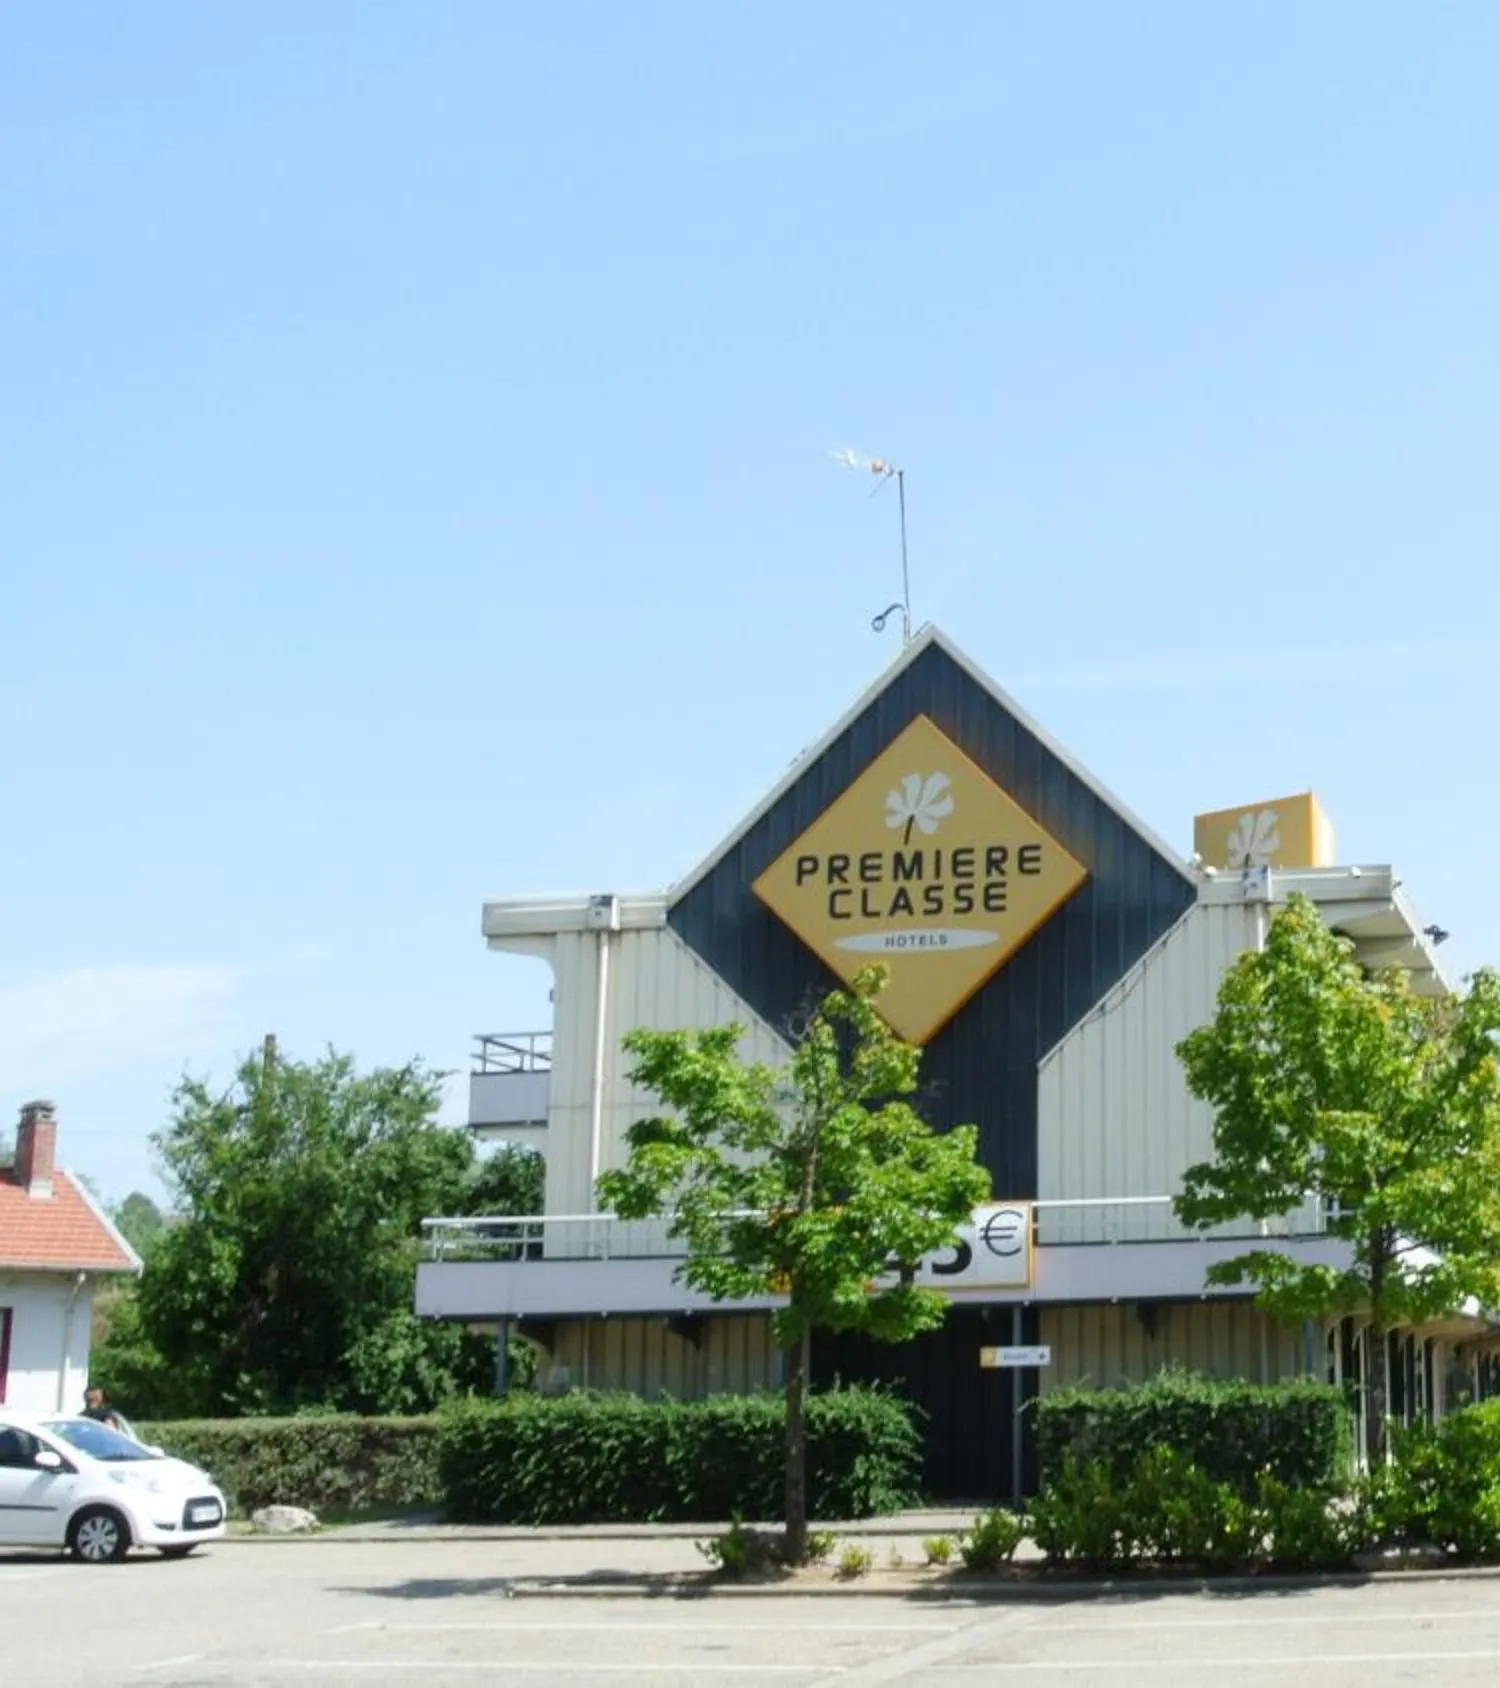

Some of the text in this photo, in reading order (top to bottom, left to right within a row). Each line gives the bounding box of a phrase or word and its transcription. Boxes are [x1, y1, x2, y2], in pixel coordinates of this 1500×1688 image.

[797, 845, 1042, 886] PREMIERE
[829, 882, 1007, 919] CLASSE
[884, 934, 948, 948] HOTELS
